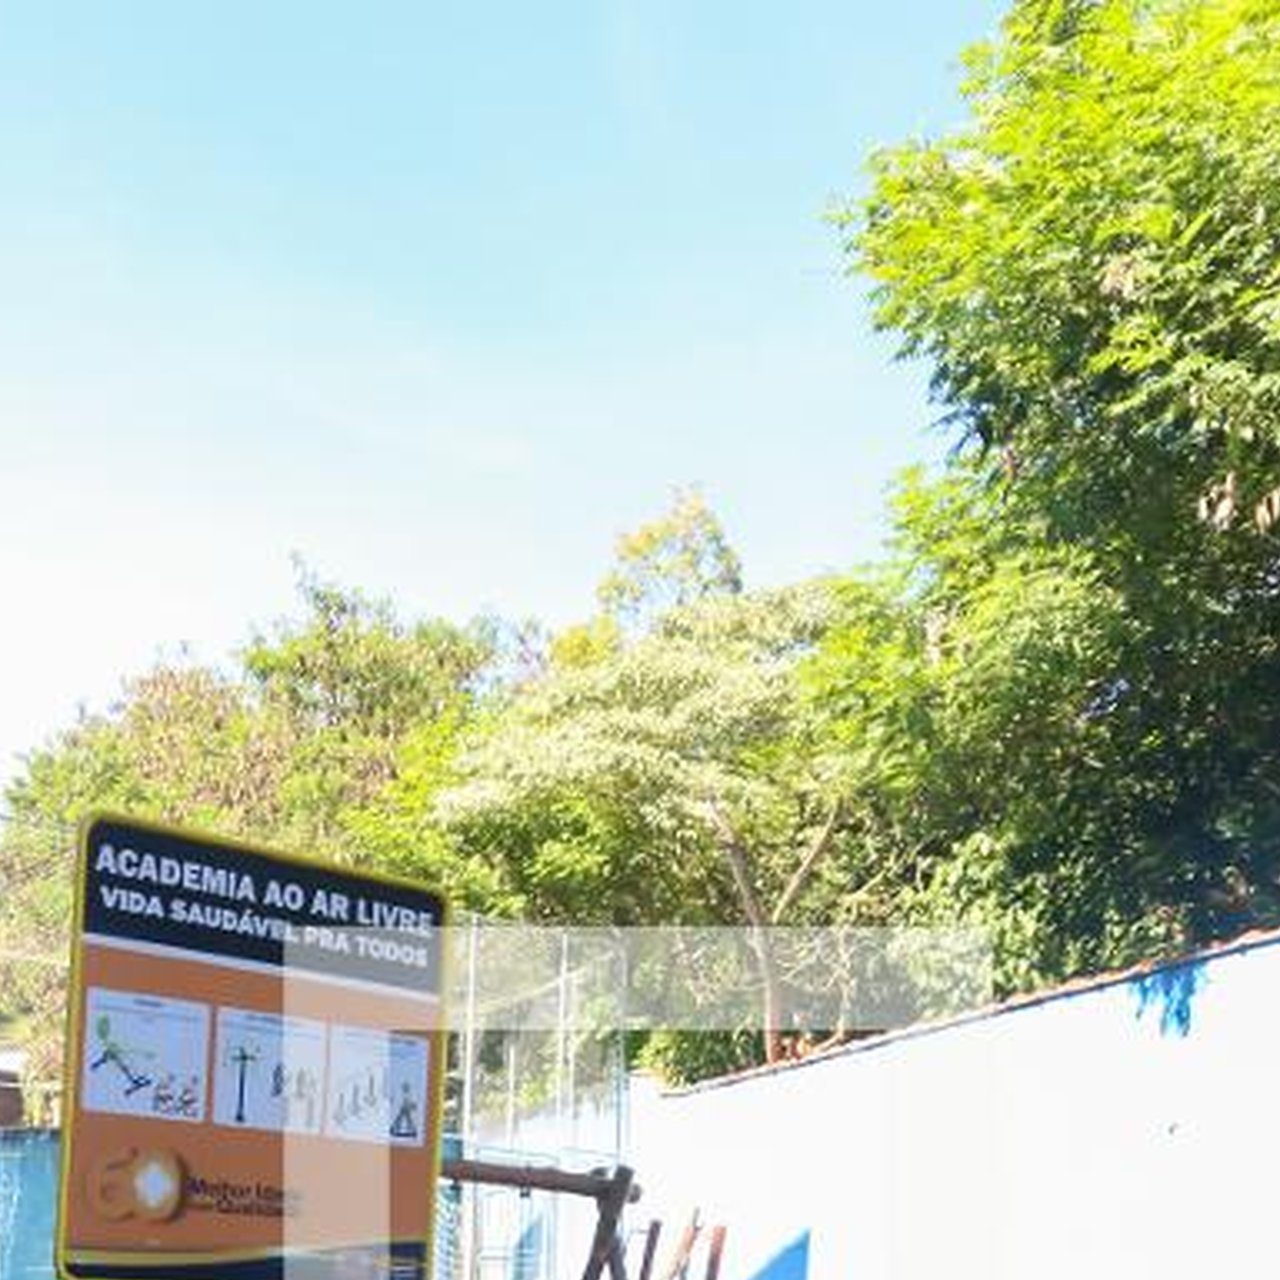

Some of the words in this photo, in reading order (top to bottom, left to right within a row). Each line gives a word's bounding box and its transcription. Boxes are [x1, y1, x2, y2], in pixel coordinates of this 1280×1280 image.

[95, 843, 256, 903] ACADEMIA
[262, 879, 305, 911] AO
[309, 889, 350, 922] AR
[357, 898, 433, 939] LIVRE
[99, 885, 164, 918] VIDA
[169, 898, 299, 943] SAUDÁVEL
[304, 925, 350, 955] PRA
[354, 935, 428, 968] TODOS
